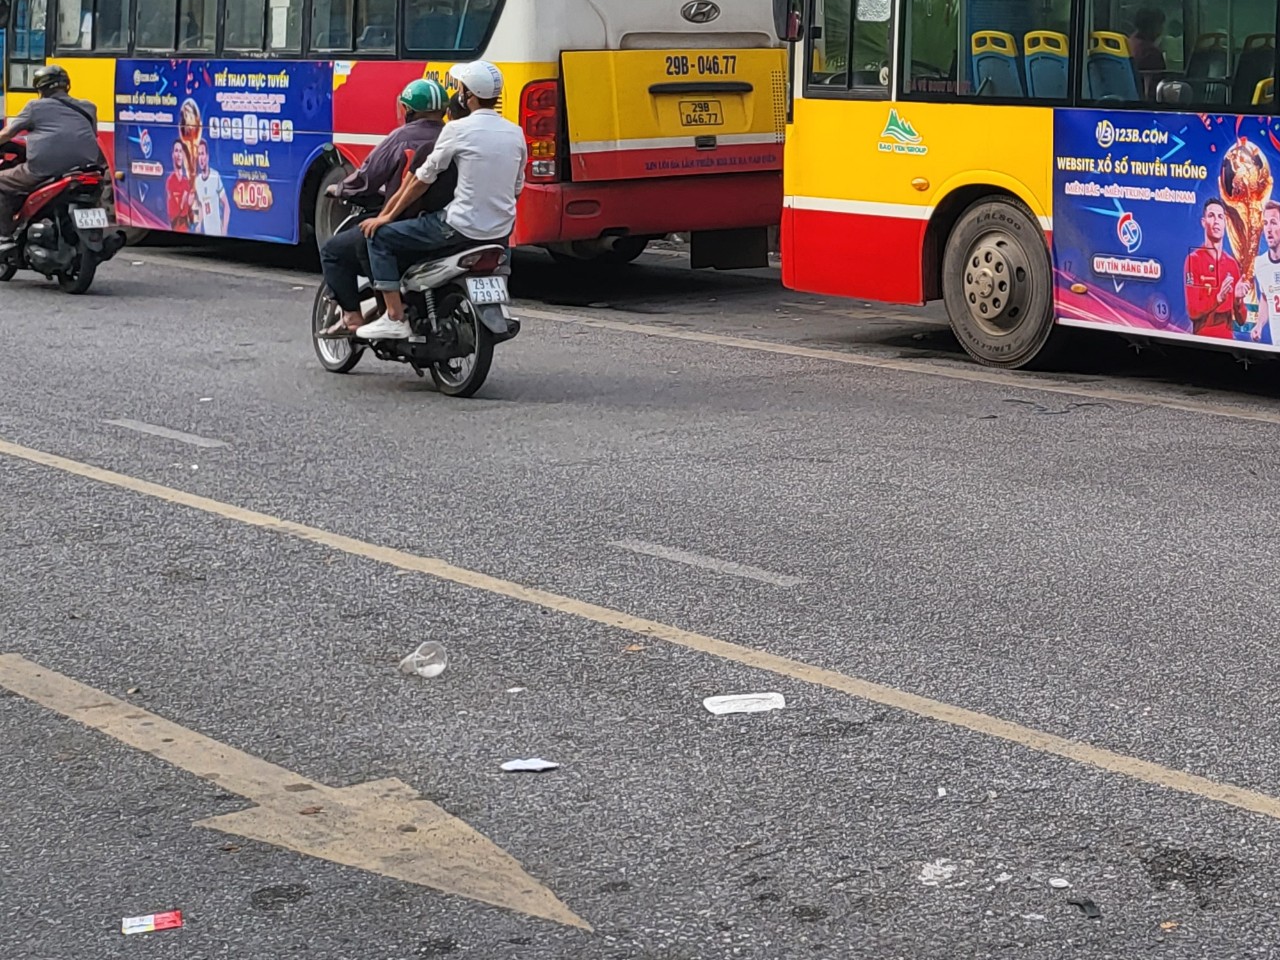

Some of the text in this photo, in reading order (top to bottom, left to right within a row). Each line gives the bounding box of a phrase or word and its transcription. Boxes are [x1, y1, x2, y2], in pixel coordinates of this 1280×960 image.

[666, 56, 689, 75] 29B
[697, 55, 737, 75] 046.77
[228, 73, 247, 87] THAO
[247, 73, 267, 91] TRỰC
[267, 69, 290, 89] TUYẾN
[691, 103, 710, 113] 29B
[685, 113, 718, 125] 046.77
[1115, 128, 1169, 144] 123B.COM
[233, 149, 255, 167] HOÀN
[1057, 153, 1208, 180] WEBSITE XỔ SỐ TRUYỀN THỐNG
[1095, 259, 1105, 270] UY
[1107, 258, 1118, 271] TÍN
[1121, 259, 1141, 274] HÀNG
[472, 277, 501, 290] 29-K1
[1156, 303, 1168, 315] 13
